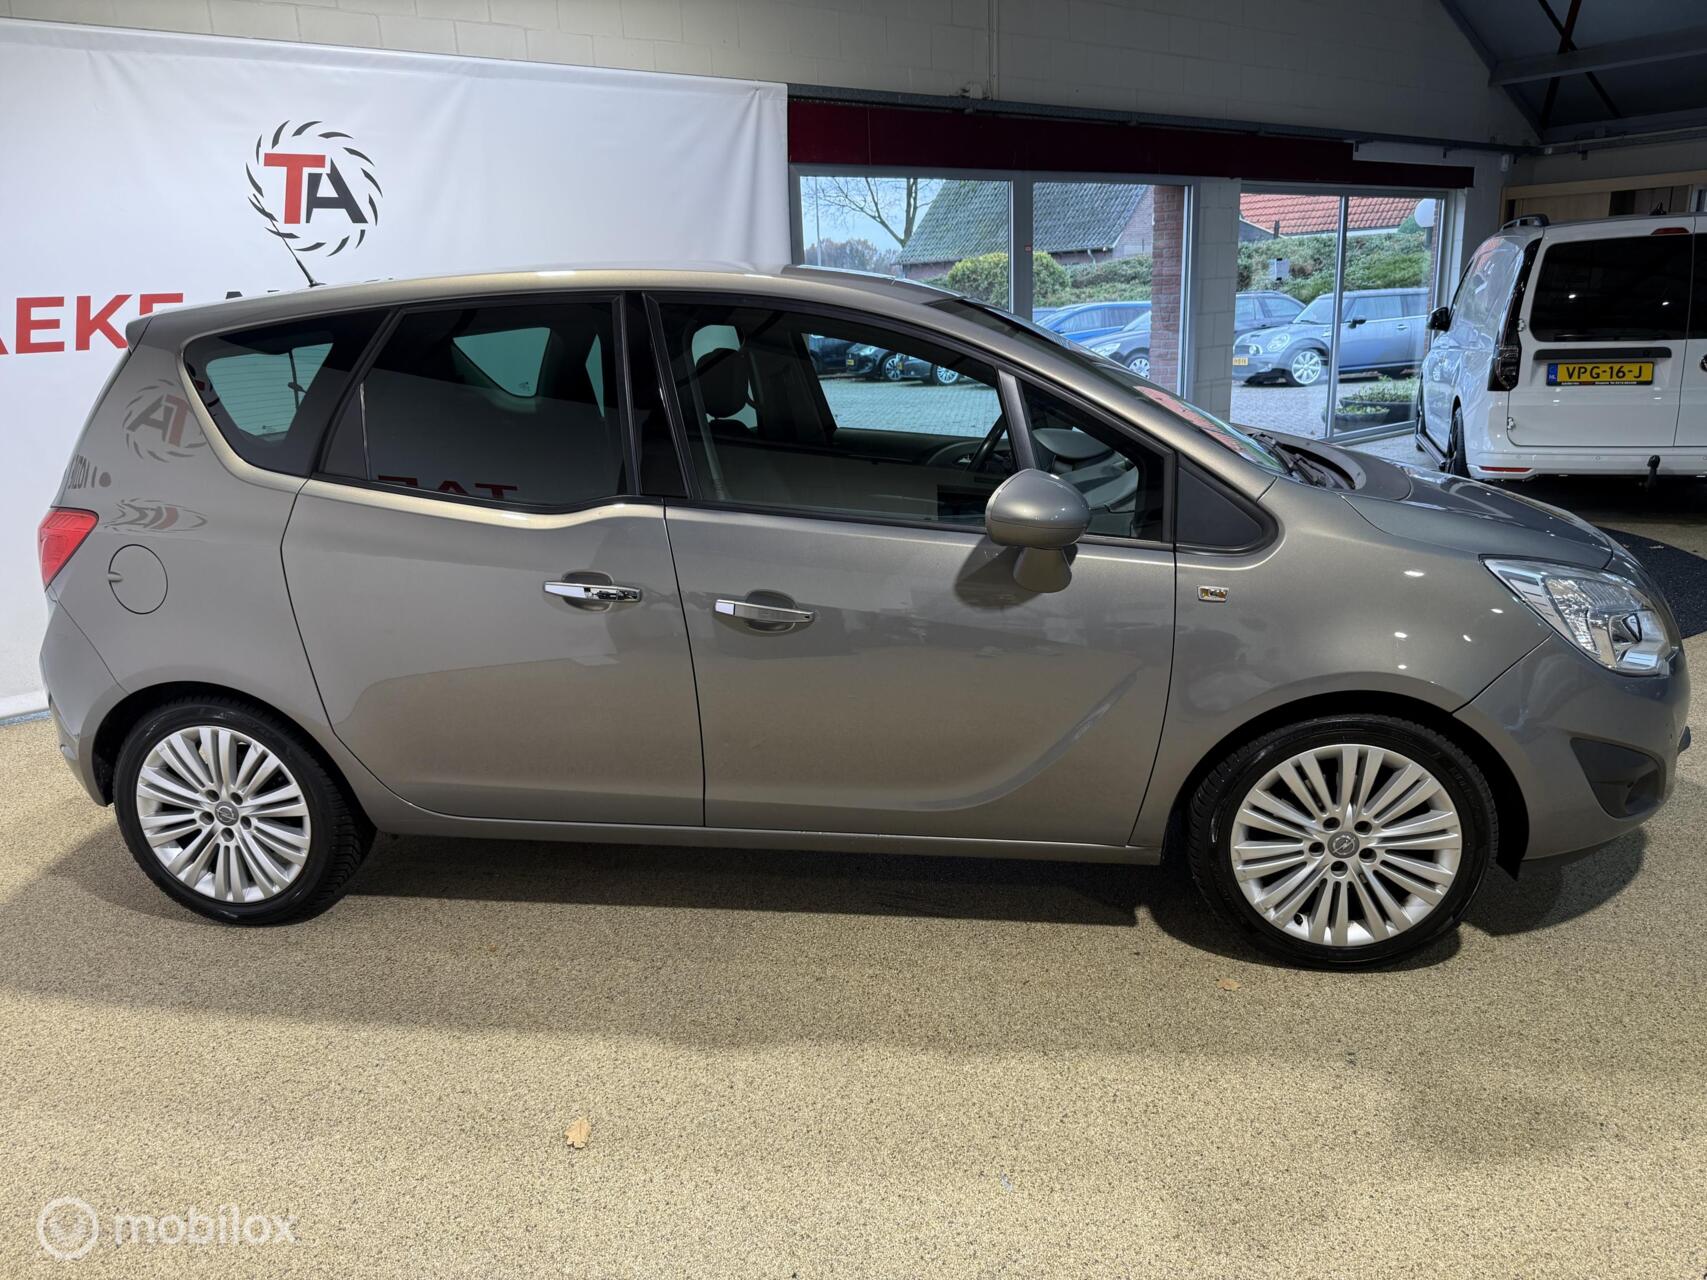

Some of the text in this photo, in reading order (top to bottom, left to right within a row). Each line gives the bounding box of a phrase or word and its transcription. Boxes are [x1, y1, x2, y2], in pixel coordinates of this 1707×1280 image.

[263, 152, 369, 224] TA
[0, 292, 184, 355] EK
[1566, 366, 1643, 380] VPG-16-J
